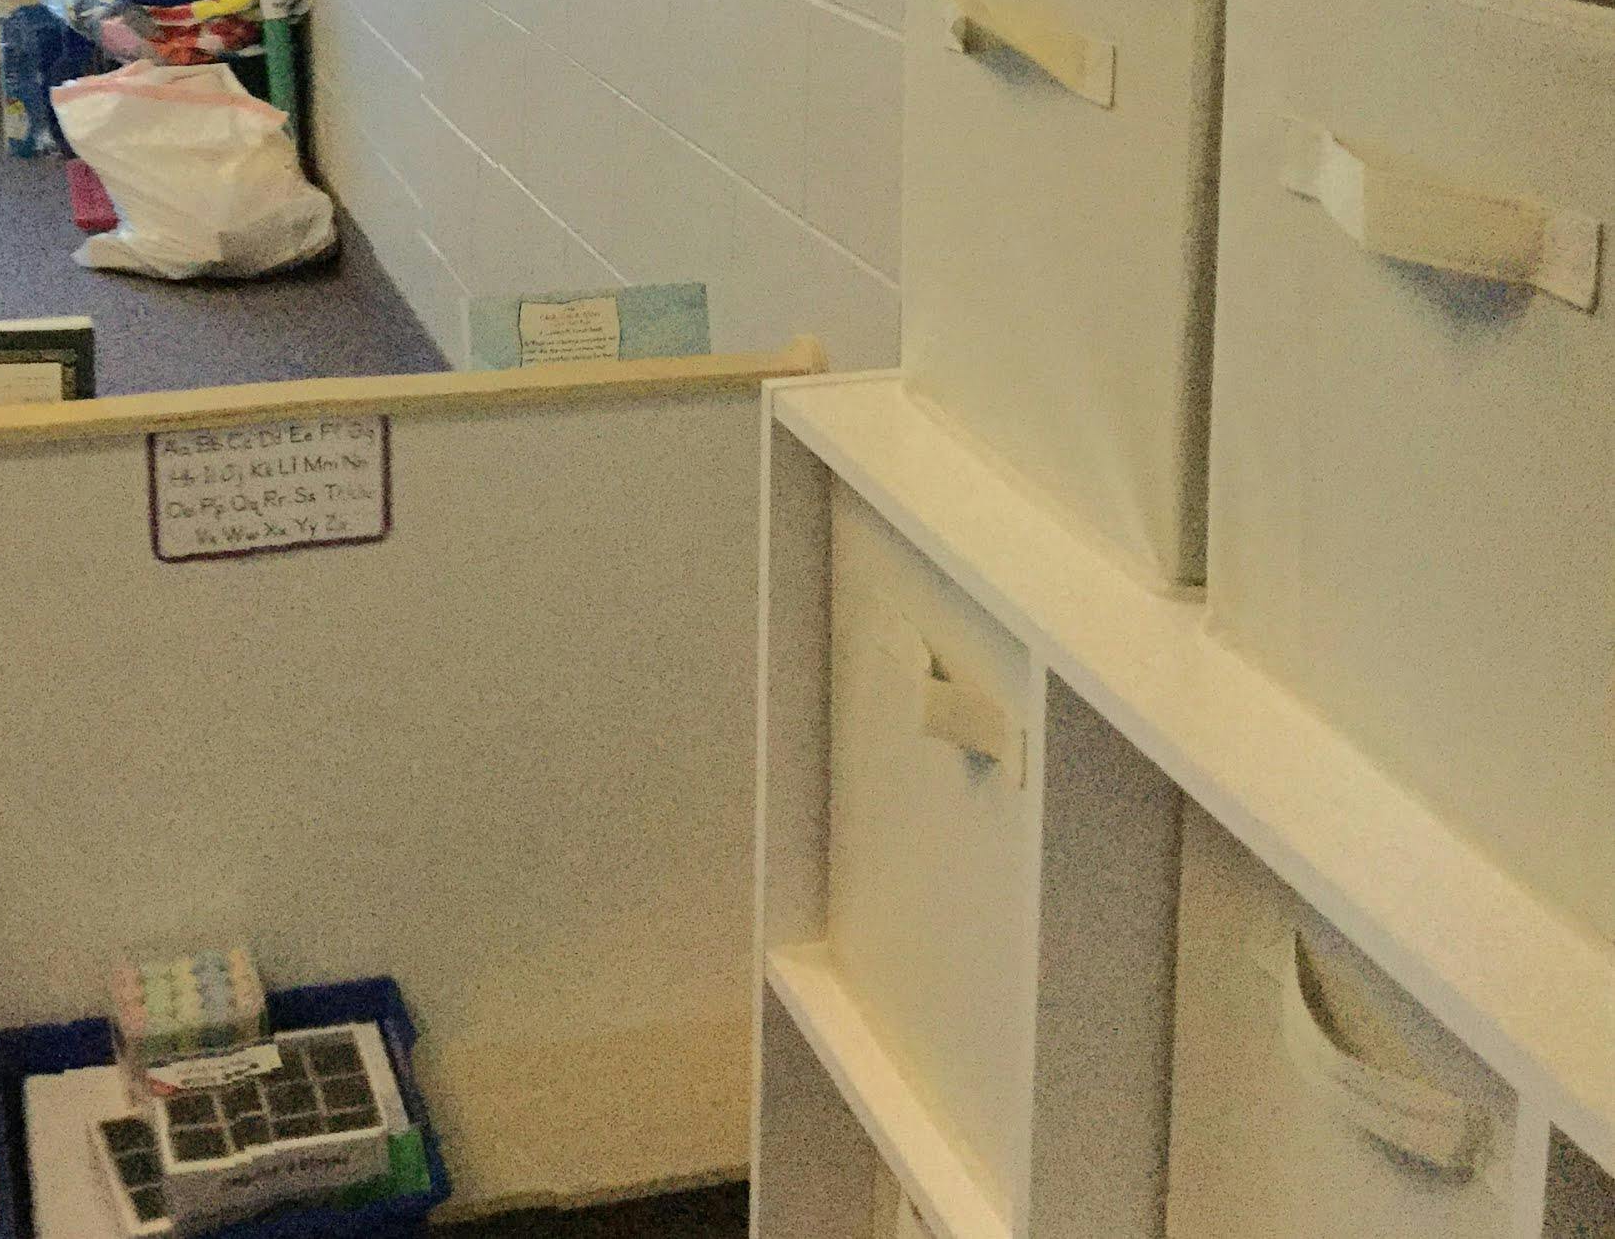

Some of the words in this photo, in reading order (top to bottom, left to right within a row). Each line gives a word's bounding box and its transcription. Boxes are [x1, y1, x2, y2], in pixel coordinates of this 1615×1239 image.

[289, 425, 312, 443] Ee
[278, 457, 297, 475] Ll
[304, 455, 338, 473] Mm
[263, 490, 285, 508] Rr
[294, 486, 316, 504] Ss
[294, 517, 317, 536] Yy
